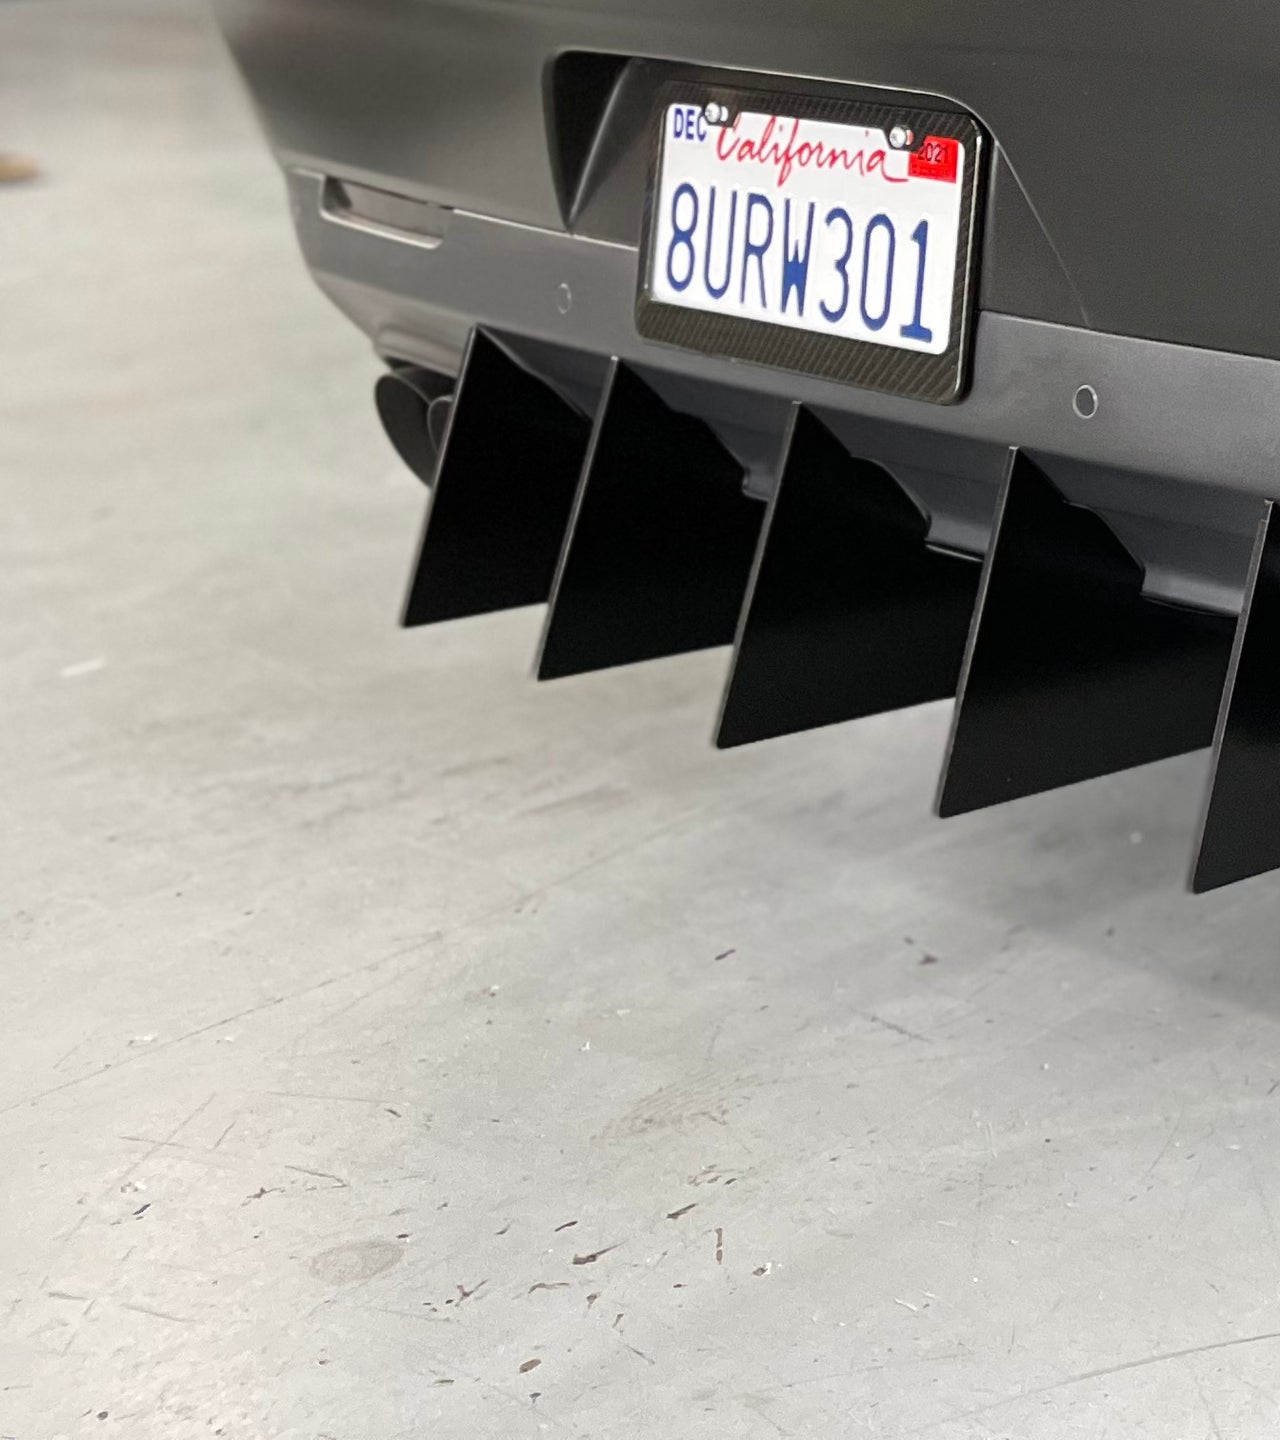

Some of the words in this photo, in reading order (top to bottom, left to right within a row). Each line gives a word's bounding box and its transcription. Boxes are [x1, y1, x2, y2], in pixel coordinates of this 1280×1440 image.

[674, 108, 707, 142] DEC
[717, 112, 908, 188] California
[666, 182, 933, 343] 8URW301
